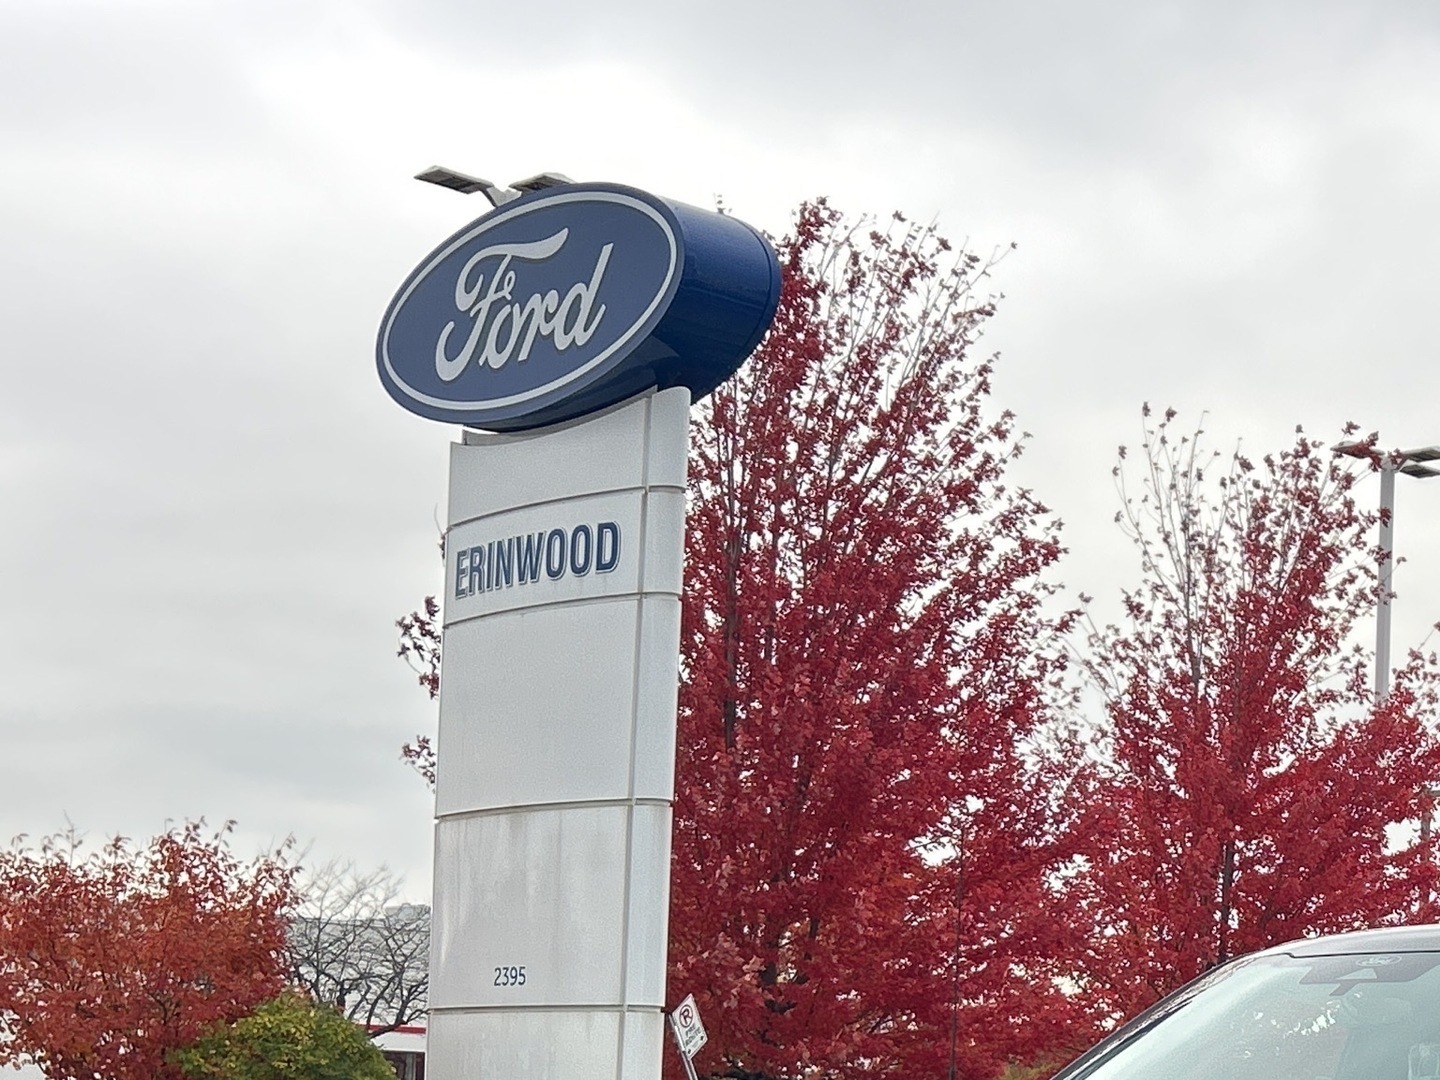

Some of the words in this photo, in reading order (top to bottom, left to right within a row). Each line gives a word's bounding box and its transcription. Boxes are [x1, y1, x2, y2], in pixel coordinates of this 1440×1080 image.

[435, 227, 614, 382] Ford
[454, 520, 622, 599] ERINWOOD
[493, 965, 527, 987] 2395
